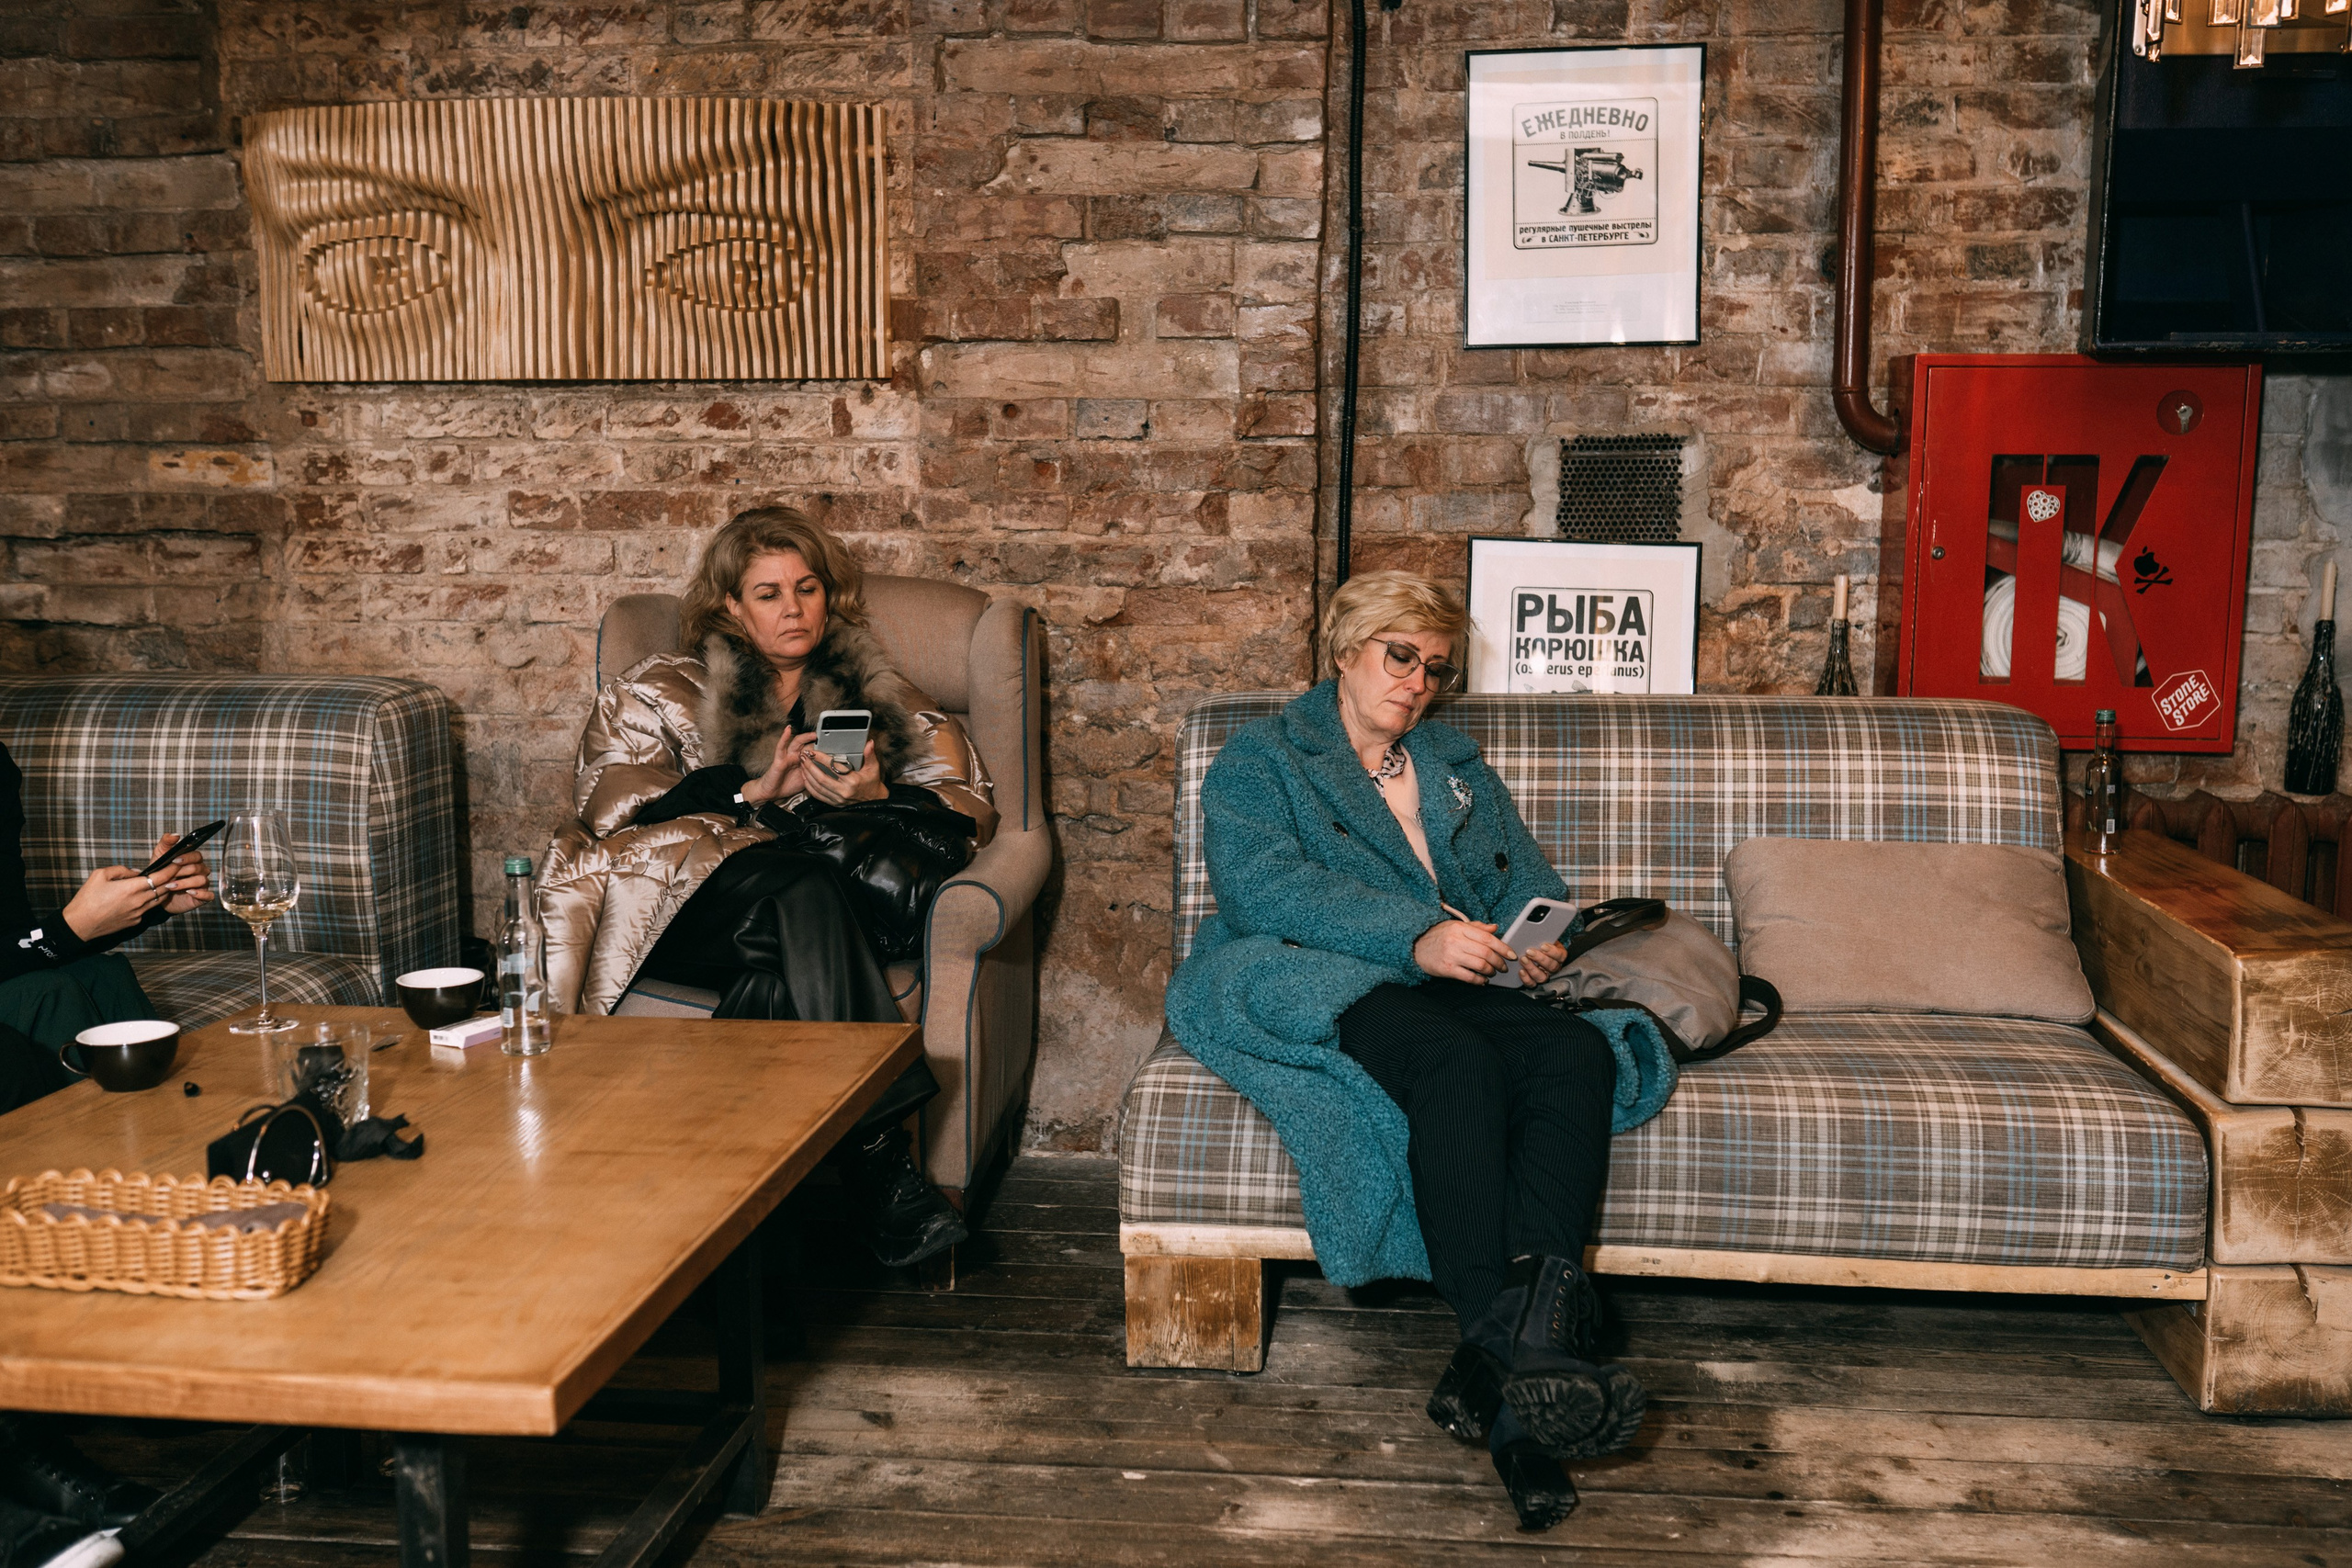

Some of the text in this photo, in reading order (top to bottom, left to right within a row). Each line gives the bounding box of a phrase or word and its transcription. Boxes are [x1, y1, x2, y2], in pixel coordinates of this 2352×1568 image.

[1521, 107, 1649, 138] ЕЖЕДНЕВНО
[1568, 130, 1611, 140] ПОЛДЕНЬ!
[1519, 221, 1652, 234] регулярные пушечные выстрелы
[1548, 231, 1630, 243] САНКТ-ПЕТЕРБУРГЕ
[1516, 592, 1646, 636] РЫБА
[1515, 661, 1574, 675] (oserus
[2160, 674, 2199, 716] STONE
[2172, 682, 2210, 727] STORE
